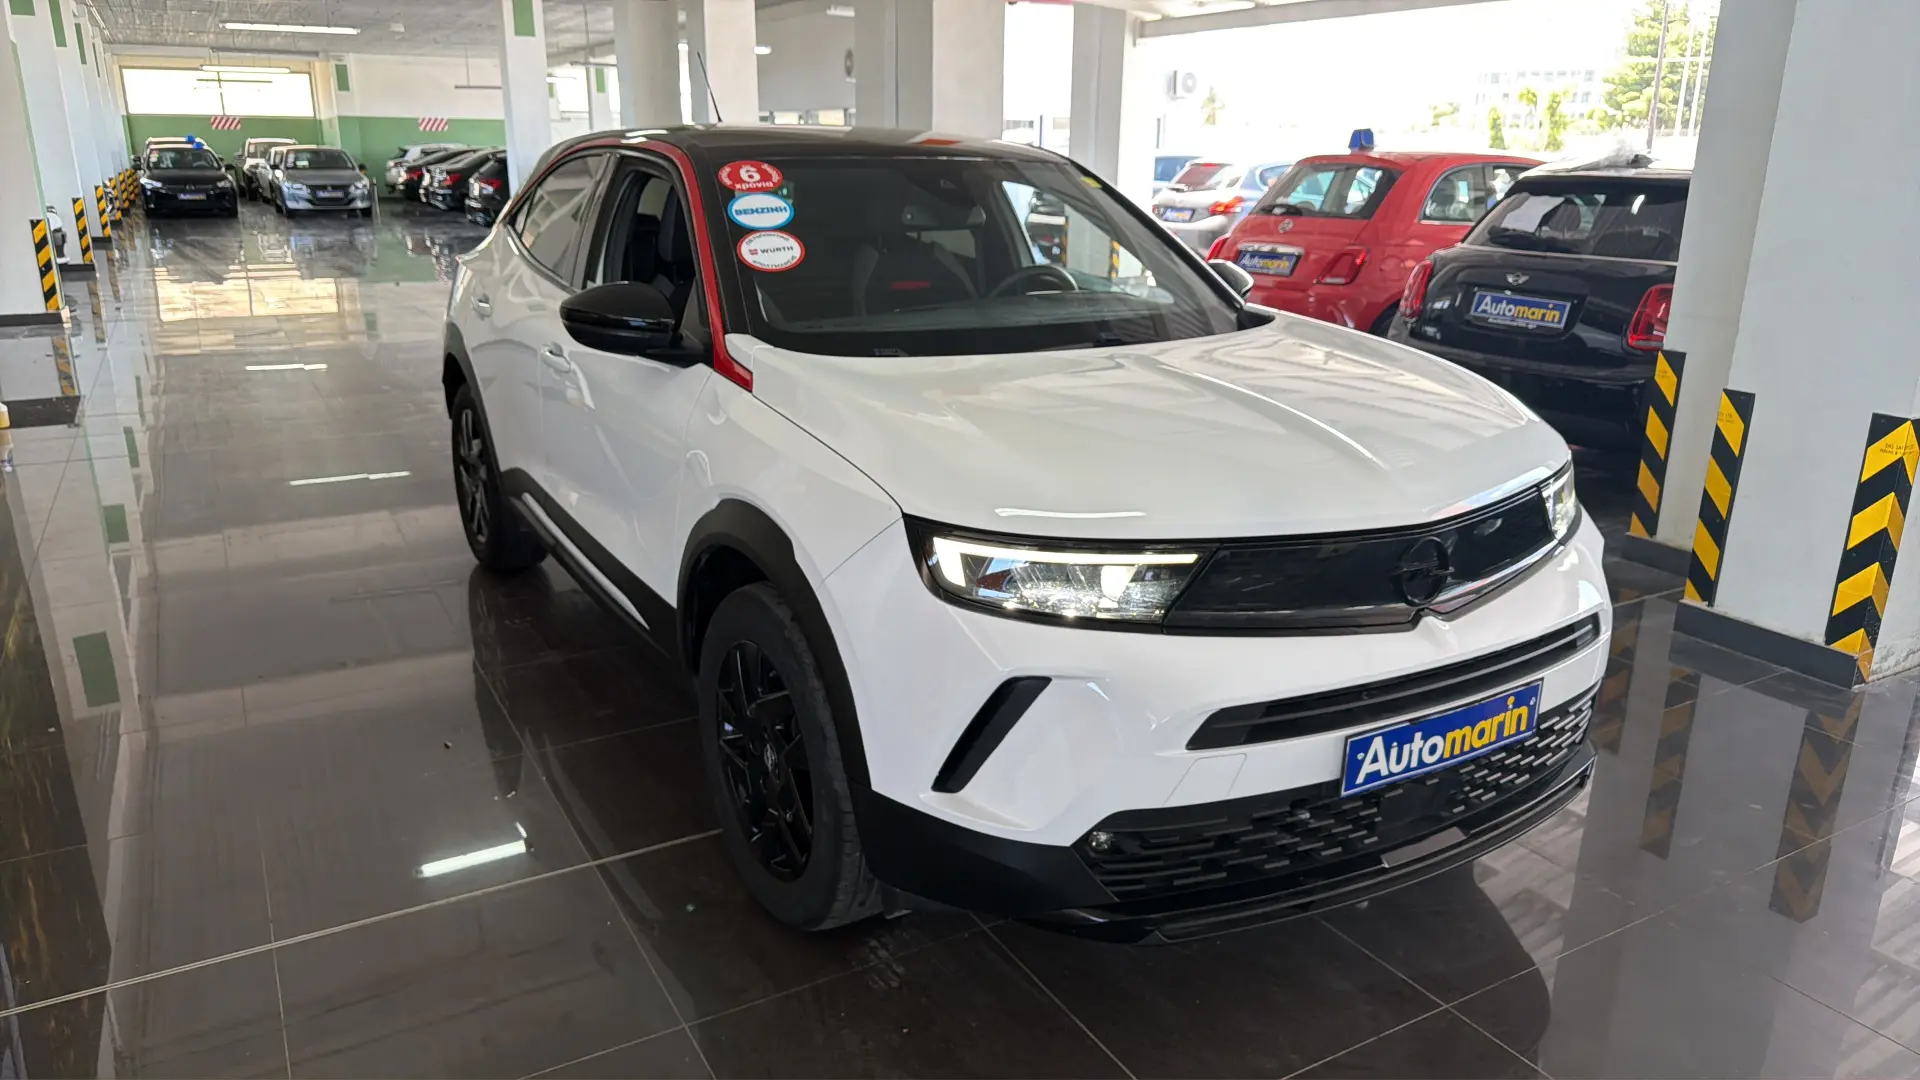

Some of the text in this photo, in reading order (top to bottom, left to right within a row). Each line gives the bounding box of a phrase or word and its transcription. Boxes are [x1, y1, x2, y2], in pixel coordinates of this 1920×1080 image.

[739, 165, 760, 183] 6
[1477, 295, 1561, 323] Automarin
[1355, 696, 1528, 785] Automarin
